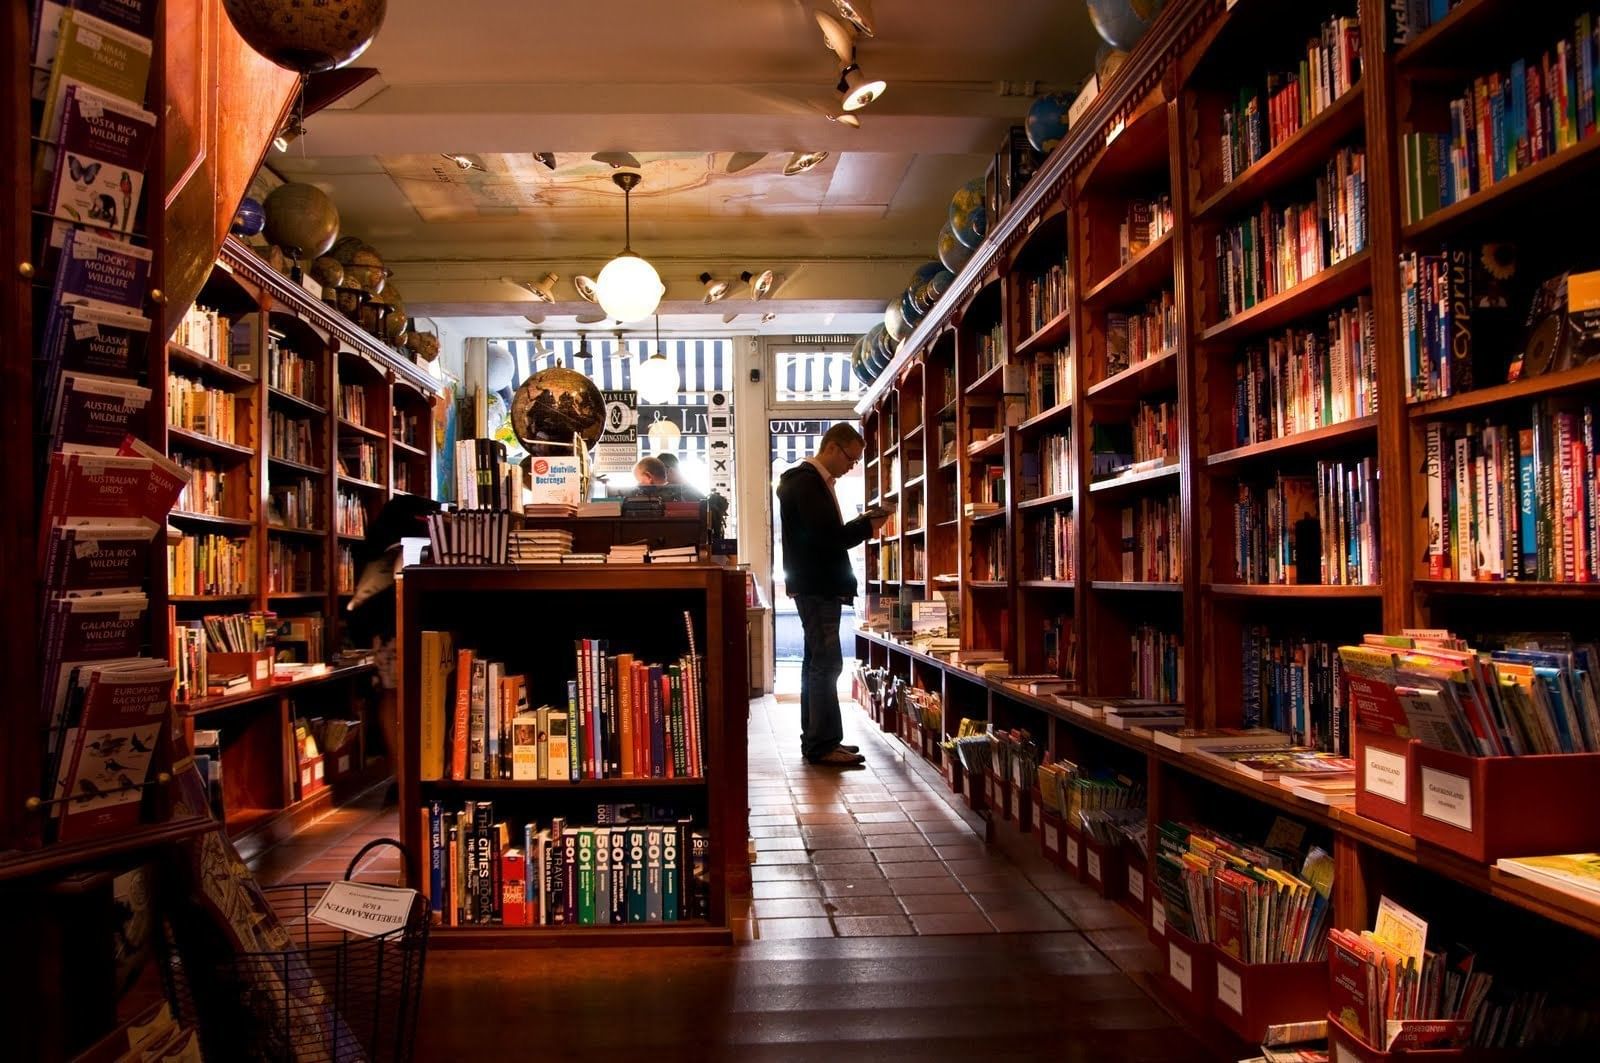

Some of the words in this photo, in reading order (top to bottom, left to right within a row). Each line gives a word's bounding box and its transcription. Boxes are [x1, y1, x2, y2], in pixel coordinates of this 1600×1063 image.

[99, 39, 128, 61] NIMAL
[90, 126, 130, 146] WILDLIFE
[117, 120, 138, 138] RICA
[84, 260, 136, 280] MOUNTAIN
[97, 252, 129, 267] ROCKY
[88, 271, 129, 289] WILDLIFE
[1453, 251, 1471, 359] Cyprus
[89, 343, 129, 357] WILDLIFE
[84, 400, 137, 414] AUSTRALIAN
[602, 393, 636, 407] TANLEY
[90, 412, 129, 424] WILDLIFE
[612, 409, 621, 425] &
[1428, 425, 1440, 479] TURKEY
[1457, 443, 1465, 484] Trotter
[88, 475, 138, 485] AUSTRALIAN
[99, 486, 124, 494] BIRDS
[1522, 463, 1534, 514] Turkey
[89, 559, 129, 569] WILDLIFE
[80, 619, 136, 631] GALAPAGOS
[86, 630, 128, 640] WILDLIFE
[112, 686, 161, 697] EUROPEAN
[622, 693, 630, 707] Yoga
[457, 689, 468, 743] RAJASTHAN
[479, 811, 488, 837] THE
[478, 838, 489, 878] CITIES
[565, 838, 575, 863] 501
[580, 834, 591, 870] 501
[596, 834, 608, 871] 501
[612, 833, 624, 870] 501
[631, 833, 643, 869] 501
[648, 831, 660, 867] 501
[664, 833, 676, 869] 501
[553, 850, 563, 893] TRAVEL
[480, 879, 490, 917] BOOK
